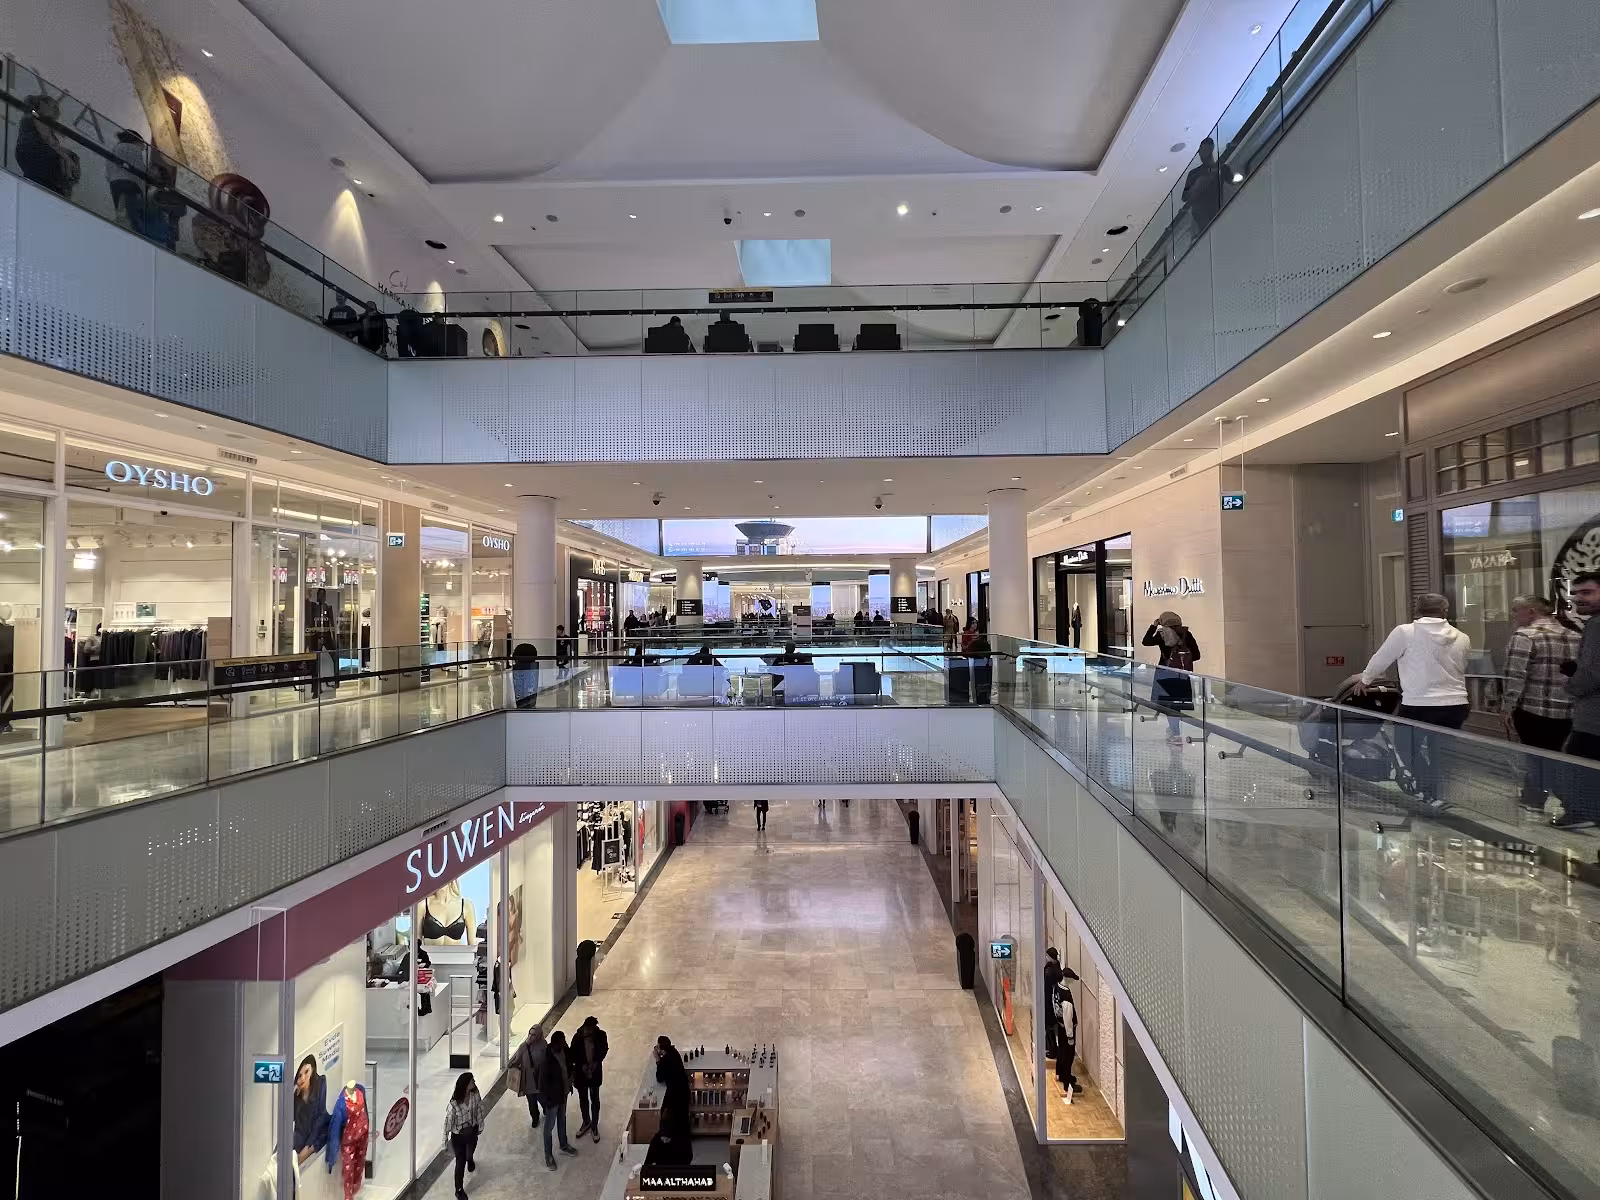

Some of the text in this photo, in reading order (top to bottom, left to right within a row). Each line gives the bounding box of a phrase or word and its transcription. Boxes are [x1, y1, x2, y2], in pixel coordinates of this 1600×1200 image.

[105, 460, 213, 496] OYSHO
[482, 535, 510, 551] OYSHO
[1143, 576, 1205, 597] Massimo Dutti
[406, 801, 546, 894] SUWEN lingerie
[642, 1178, 663, 1186] MAA
